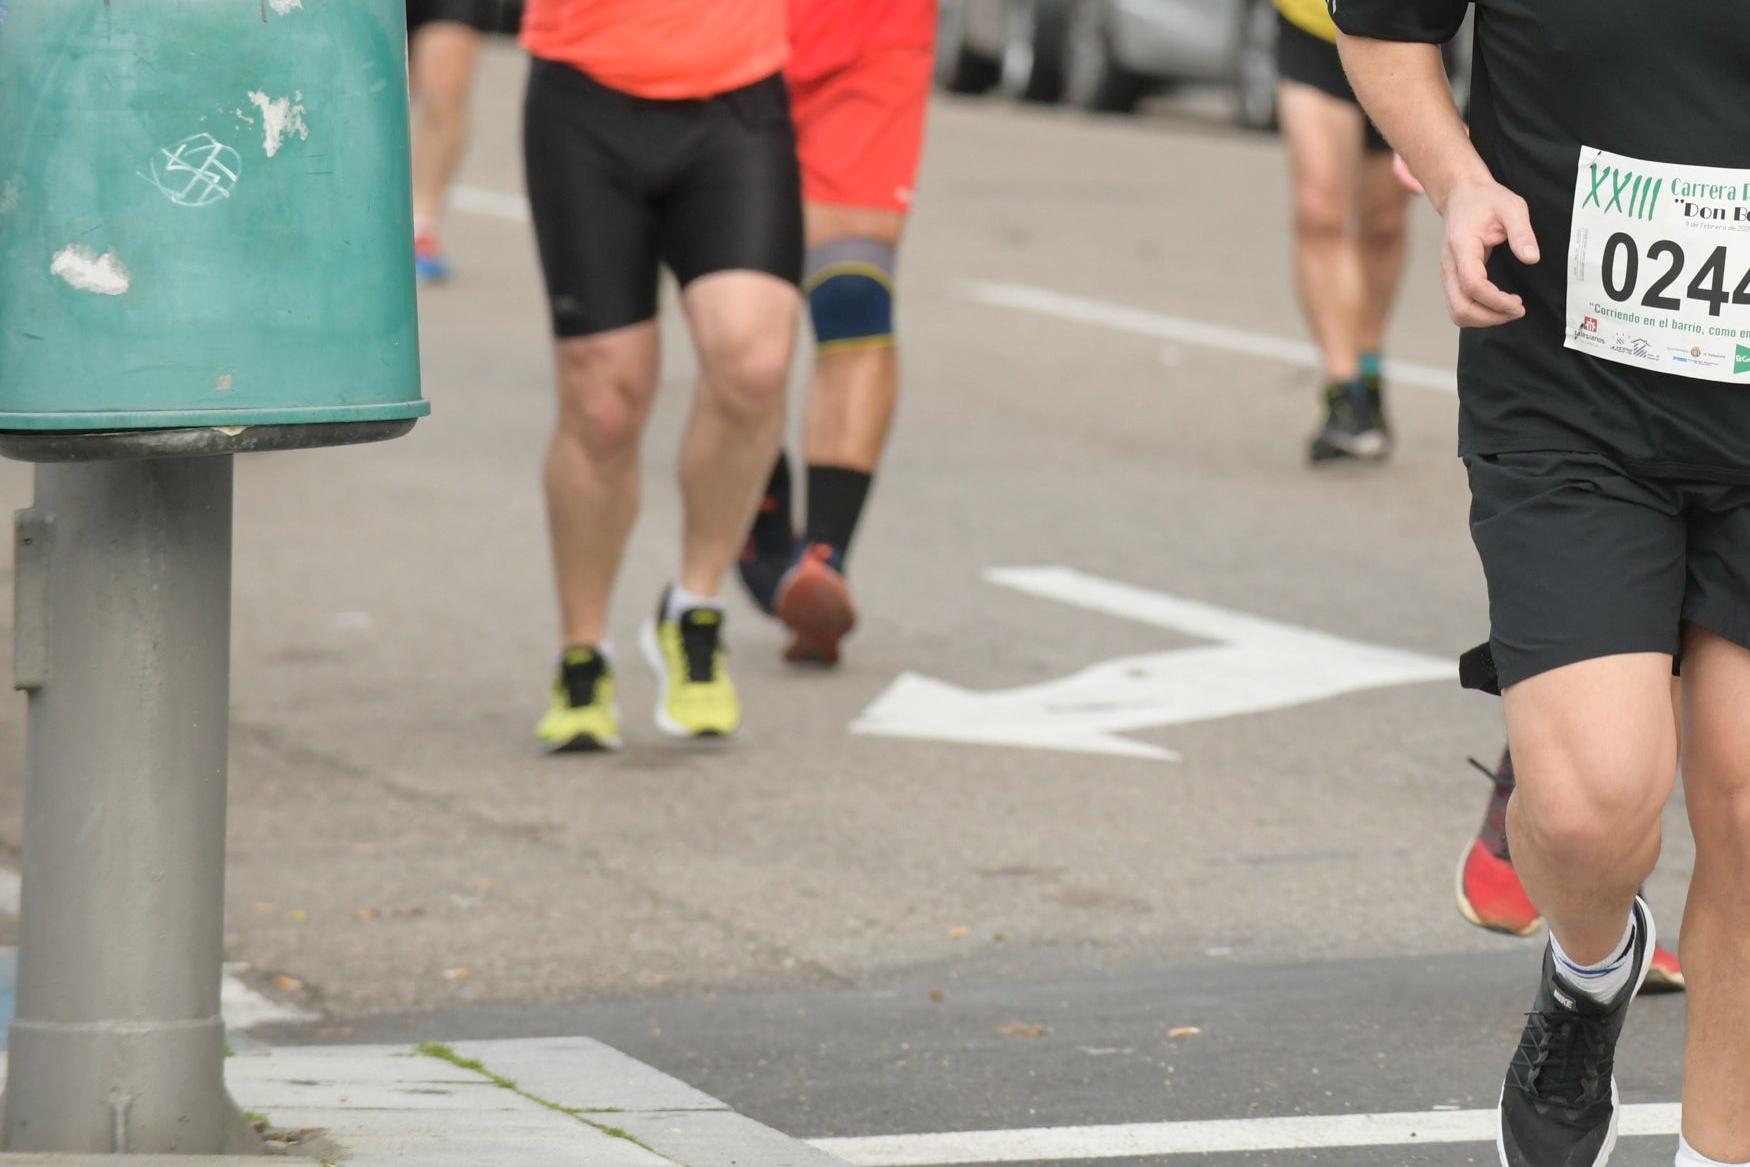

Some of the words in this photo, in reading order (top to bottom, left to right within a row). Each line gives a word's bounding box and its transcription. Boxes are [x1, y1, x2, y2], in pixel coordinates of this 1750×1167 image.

[1582, 163, 1663, 222] XXIII
[1671, 178, 1737, 200] Carrera
[1643, 317, 1656, 327] en
[1659, 318, 1669, 328] el
[1671, 319, 1705, 335] barrio,
[1709, 326, 1736, 338] como
[1553, 989, 1573, 1009] NIKE
